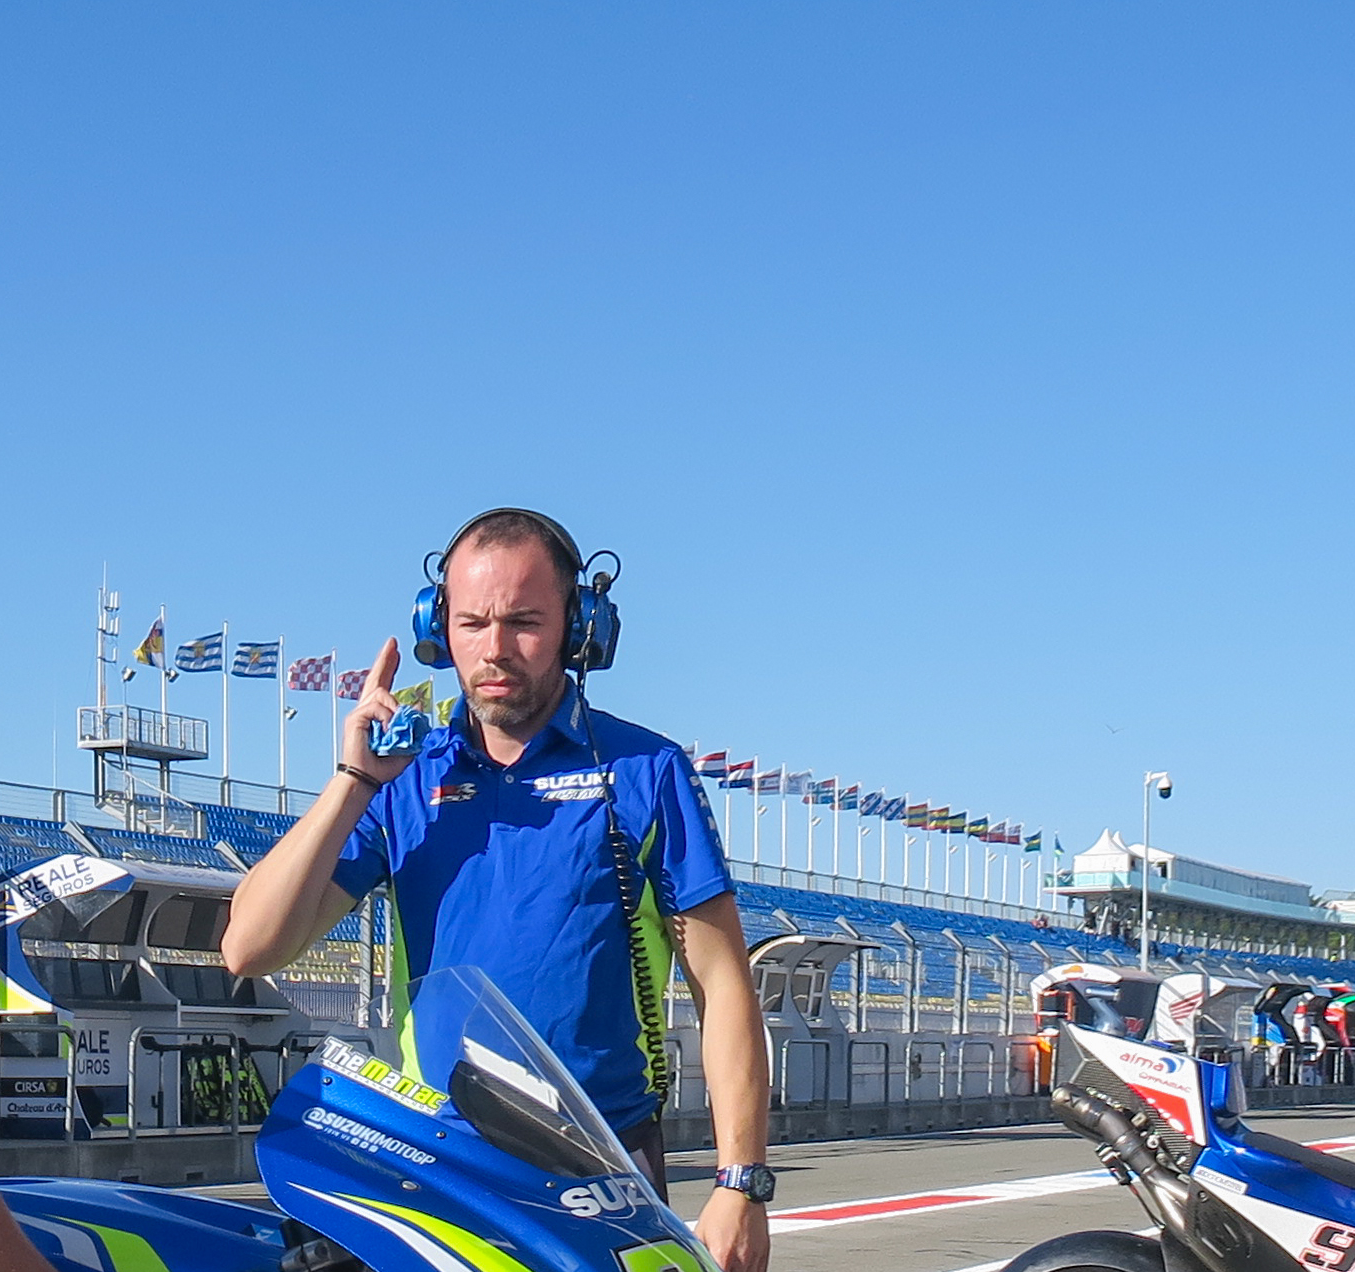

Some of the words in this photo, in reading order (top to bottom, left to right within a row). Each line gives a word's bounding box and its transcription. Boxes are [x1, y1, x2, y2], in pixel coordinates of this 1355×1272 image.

[18, 853, 90, 895] REALE
[23, 873, 94, 911] SEGUROS
[76, 1030, 110, 1053] ALE
[15, 1081, 45, 1093] CIRSA
[302, 1107, 436, 1165] @SUZUKIMOTOGP
